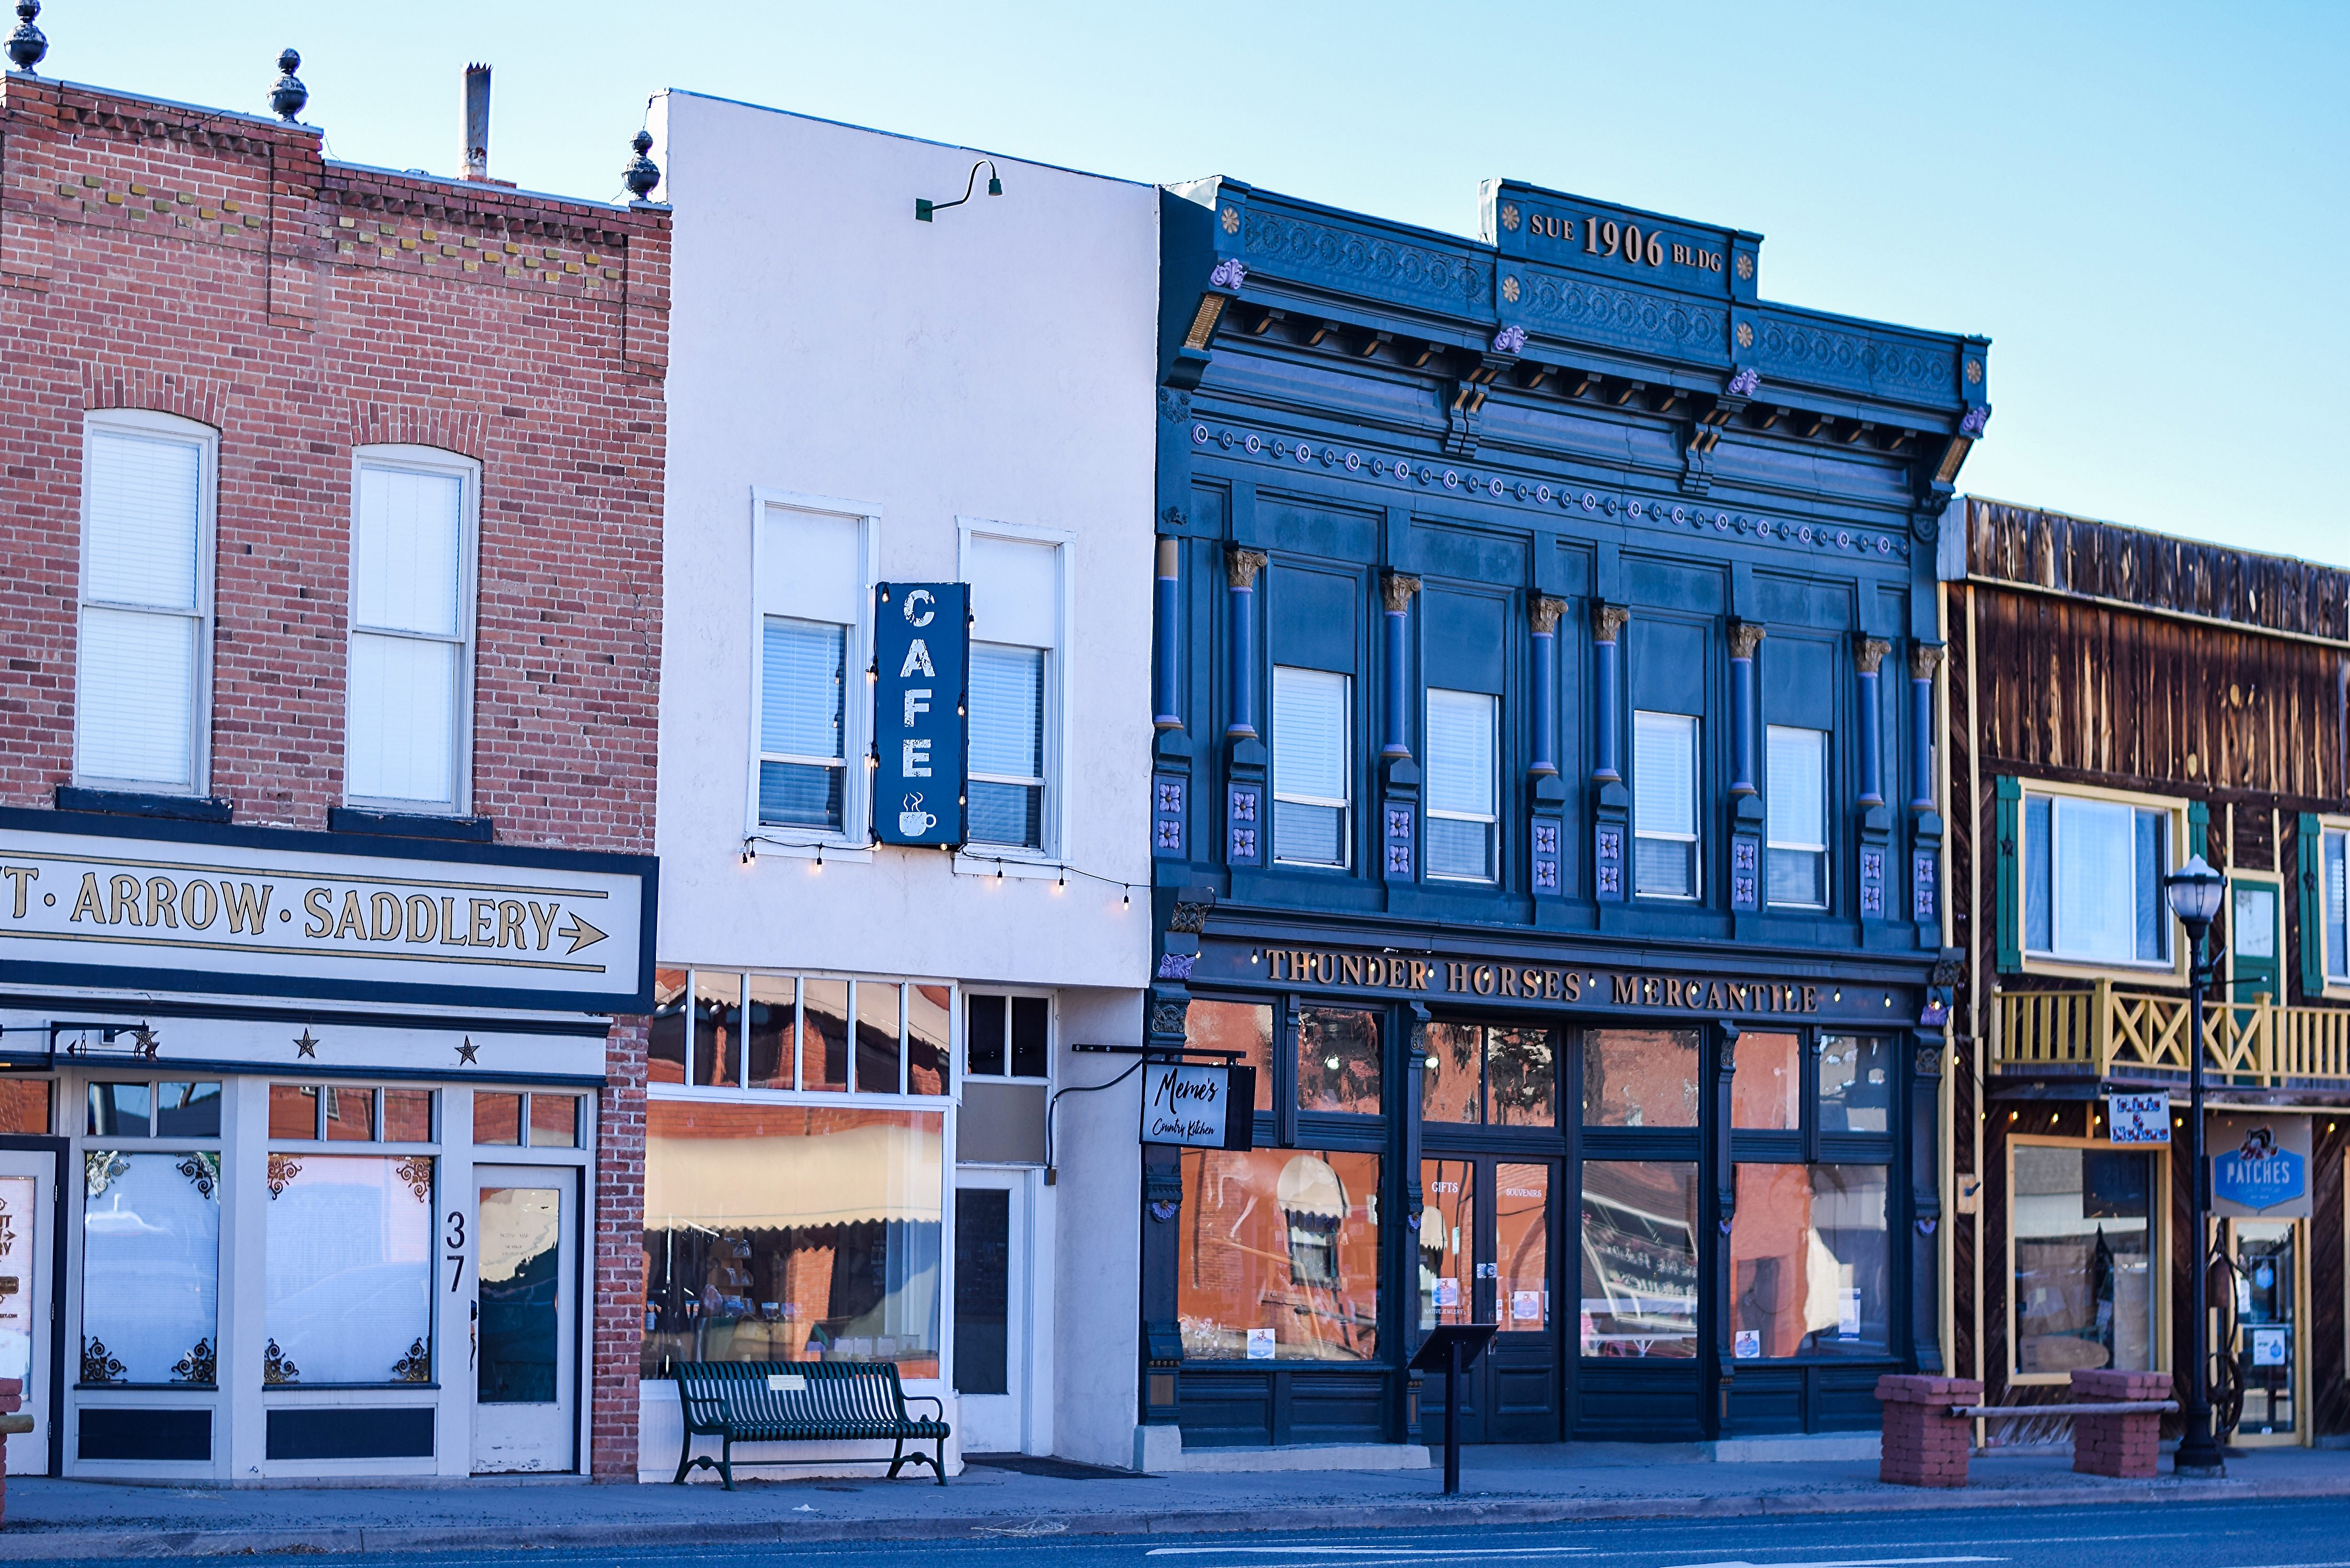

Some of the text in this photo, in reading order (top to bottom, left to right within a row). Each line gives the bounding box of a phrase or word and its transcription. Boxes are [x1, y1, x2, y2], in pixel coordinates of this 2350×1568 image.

[1530, 214, 1722, 272] SUE 1906 BLDG
[900, 590, 936, 777] CAFE
[0, 865, 560, 951] T ARROW SADDLERY
[1264, 949, 1817, 1012] THUNDER HORSES MERCANTILE
[1154, 1067, 1219, 1114] Meme's
[1152, 1117, 1215, 1142] Country Kitchen
[1432, 1182, 1458, 1193] GIFTS
[1506, 1187, 1541, 1198] SOUVENIRS
[2227, 1161, 2290, 1184] PATCHES
